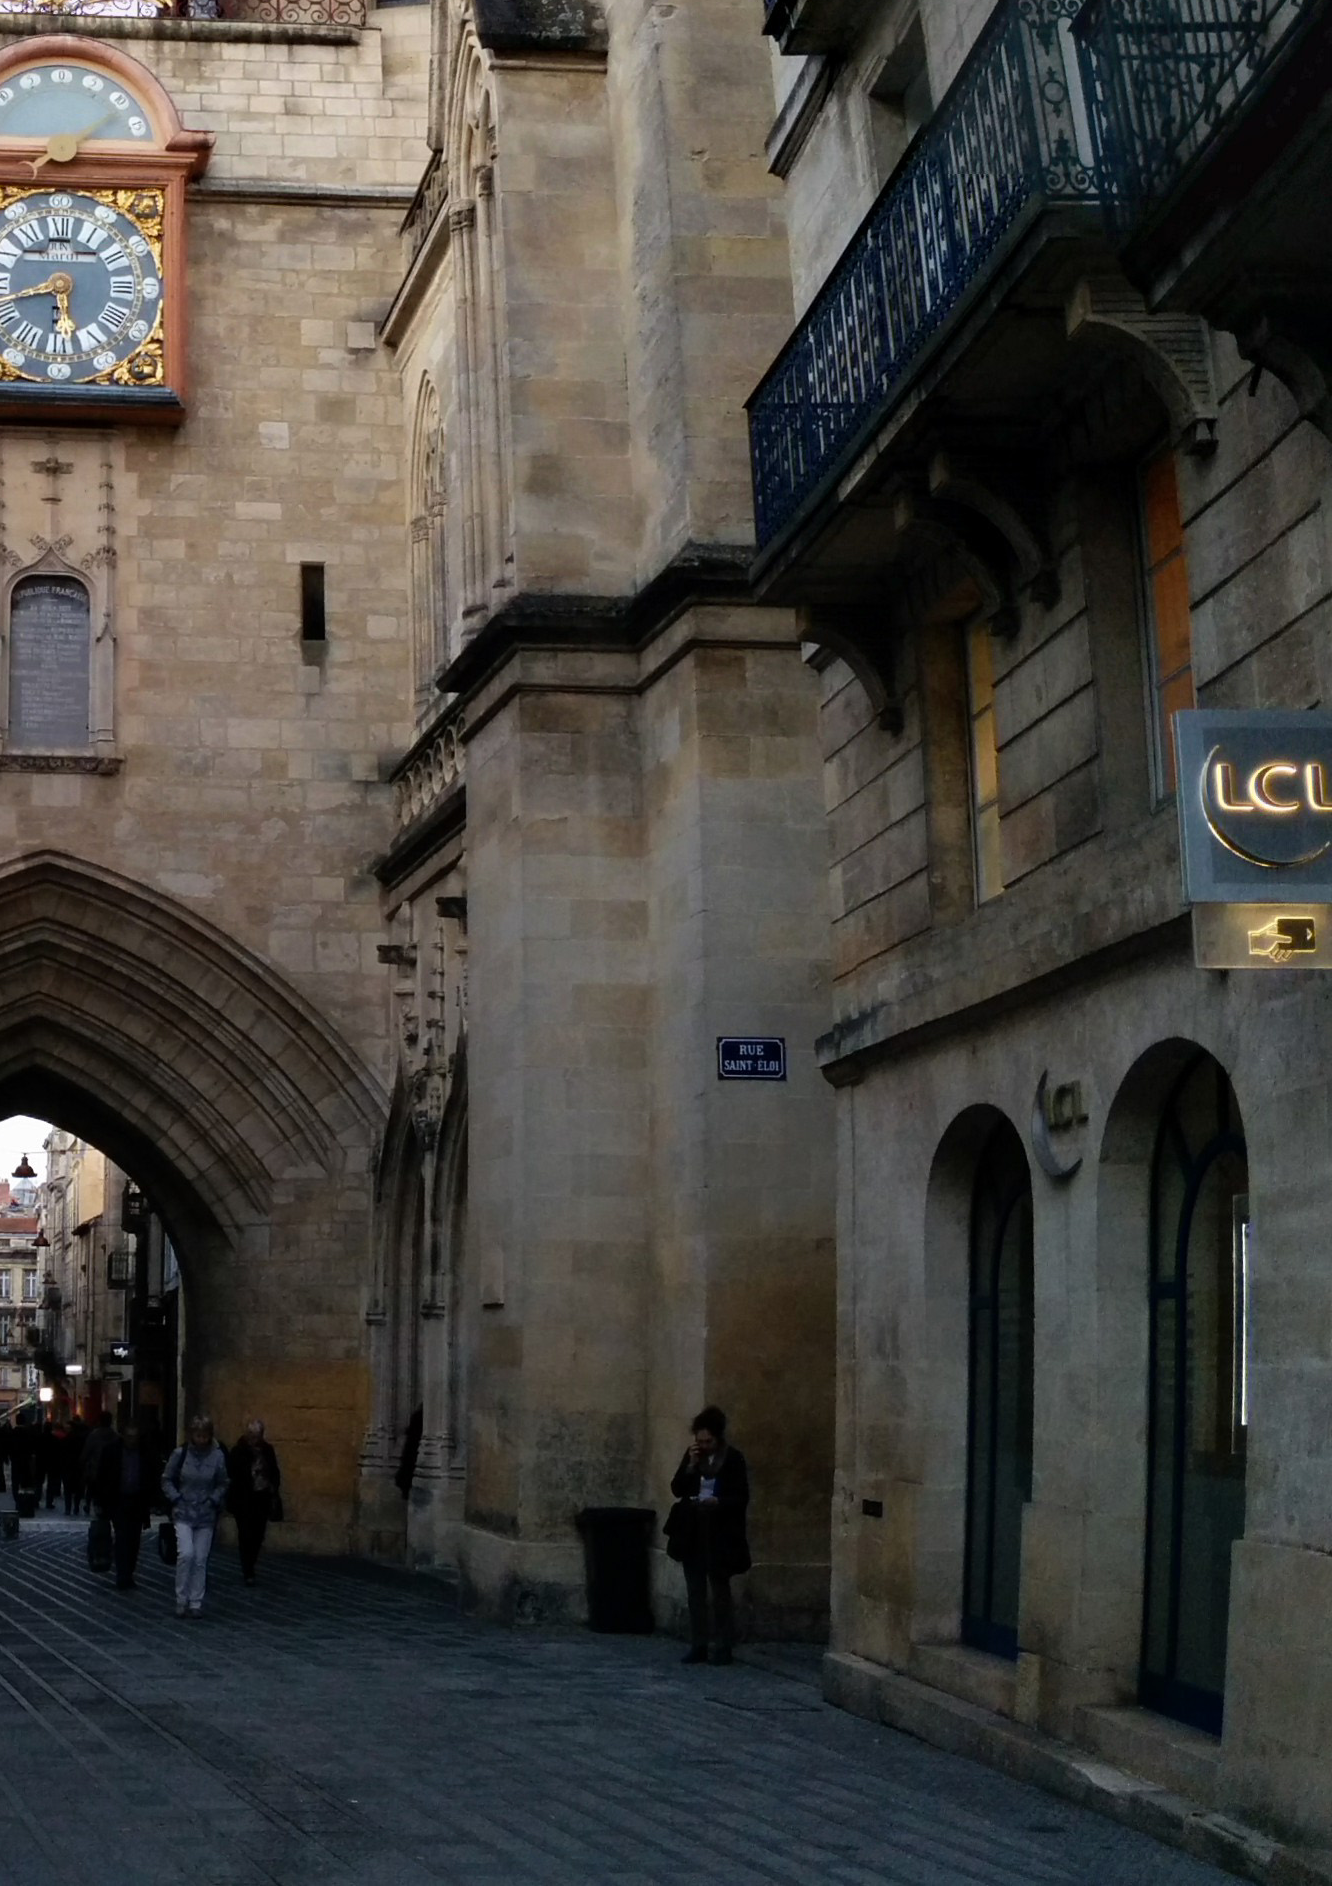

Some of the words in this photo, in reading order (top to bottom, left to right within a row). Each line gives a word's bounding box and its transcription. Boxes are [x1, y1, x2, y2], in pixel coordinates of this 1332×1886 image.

[52, 195, 70, 207] 60
[50, 217, 70, 236] XII
[112, 280, 133, 294] III
[1215, 763, 1332, 811] LCL
[739, 1044, 764, 1056] RUE
[1043, 1080, 1089, 1130] LCL
